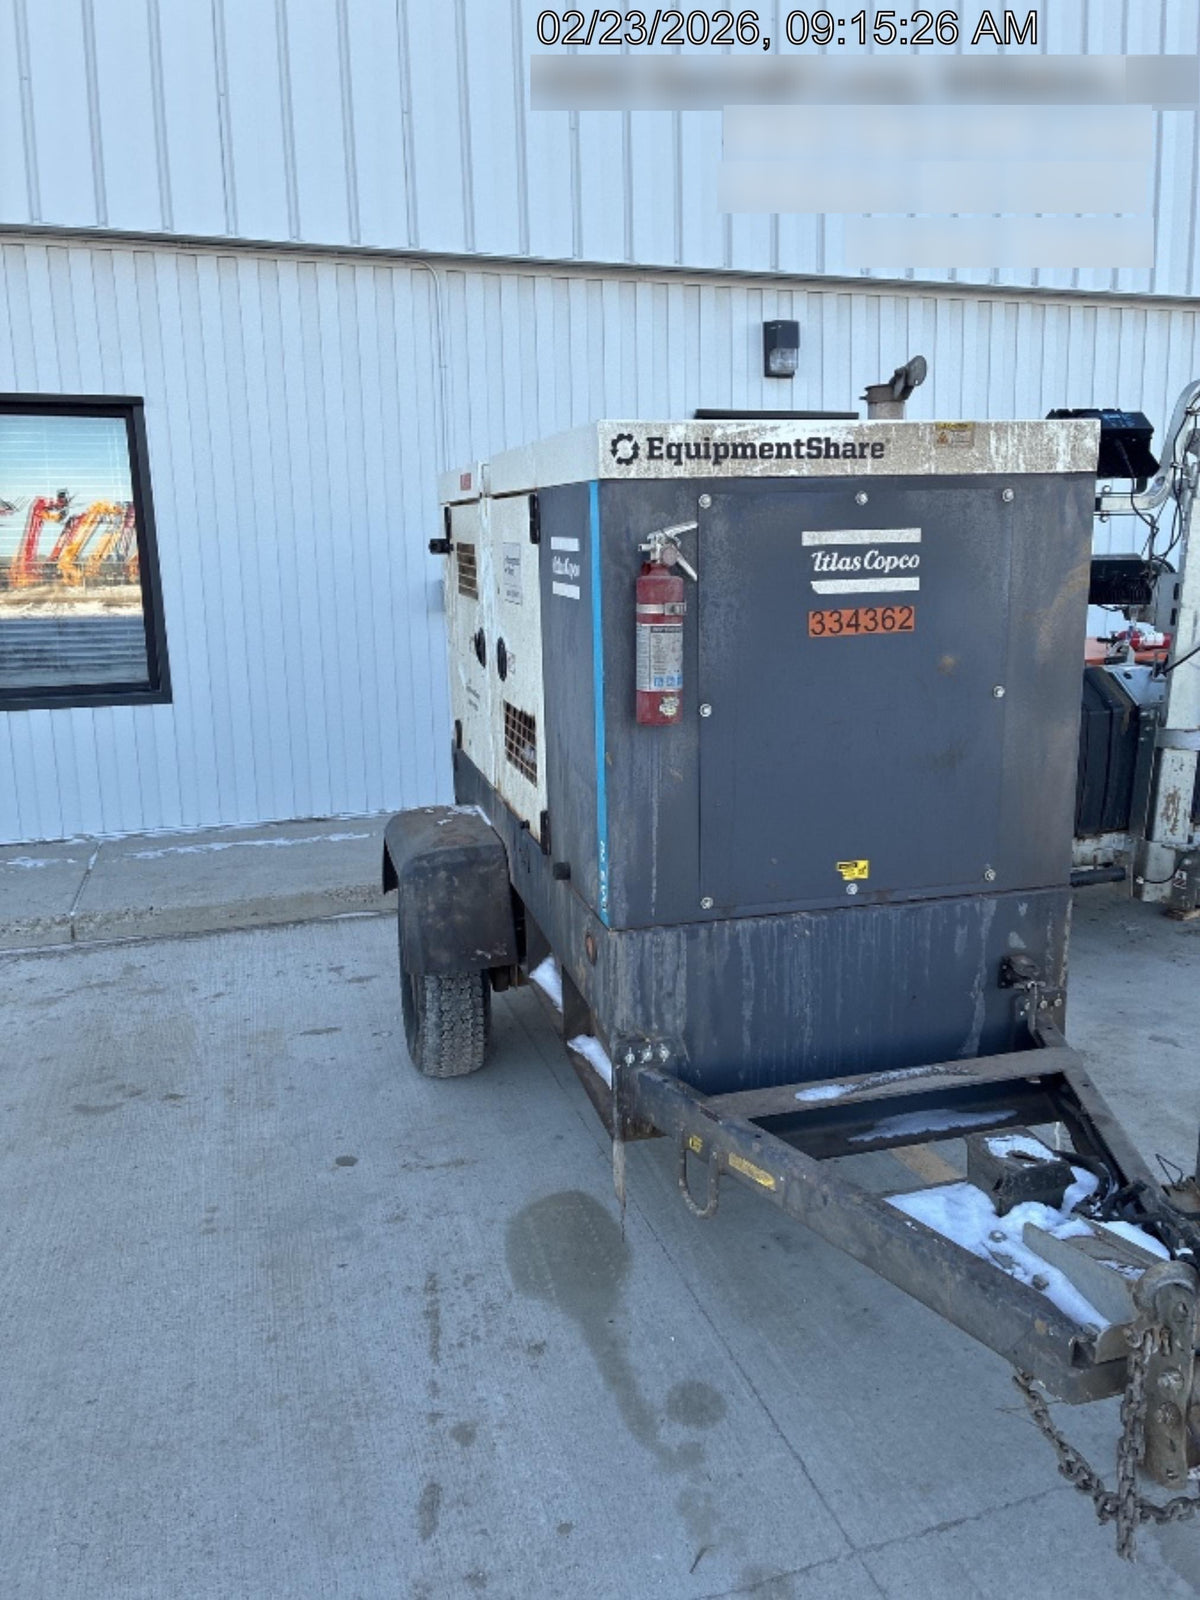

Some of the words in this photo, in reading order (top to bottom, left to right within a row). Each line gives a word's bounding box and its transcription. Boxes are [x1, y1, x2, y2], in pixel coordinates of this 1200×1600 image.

[646, 436, 885, 466] EquipmentShare
[863, 549, 920, 573] Copco
[811, 606, 913, 635] 334362
